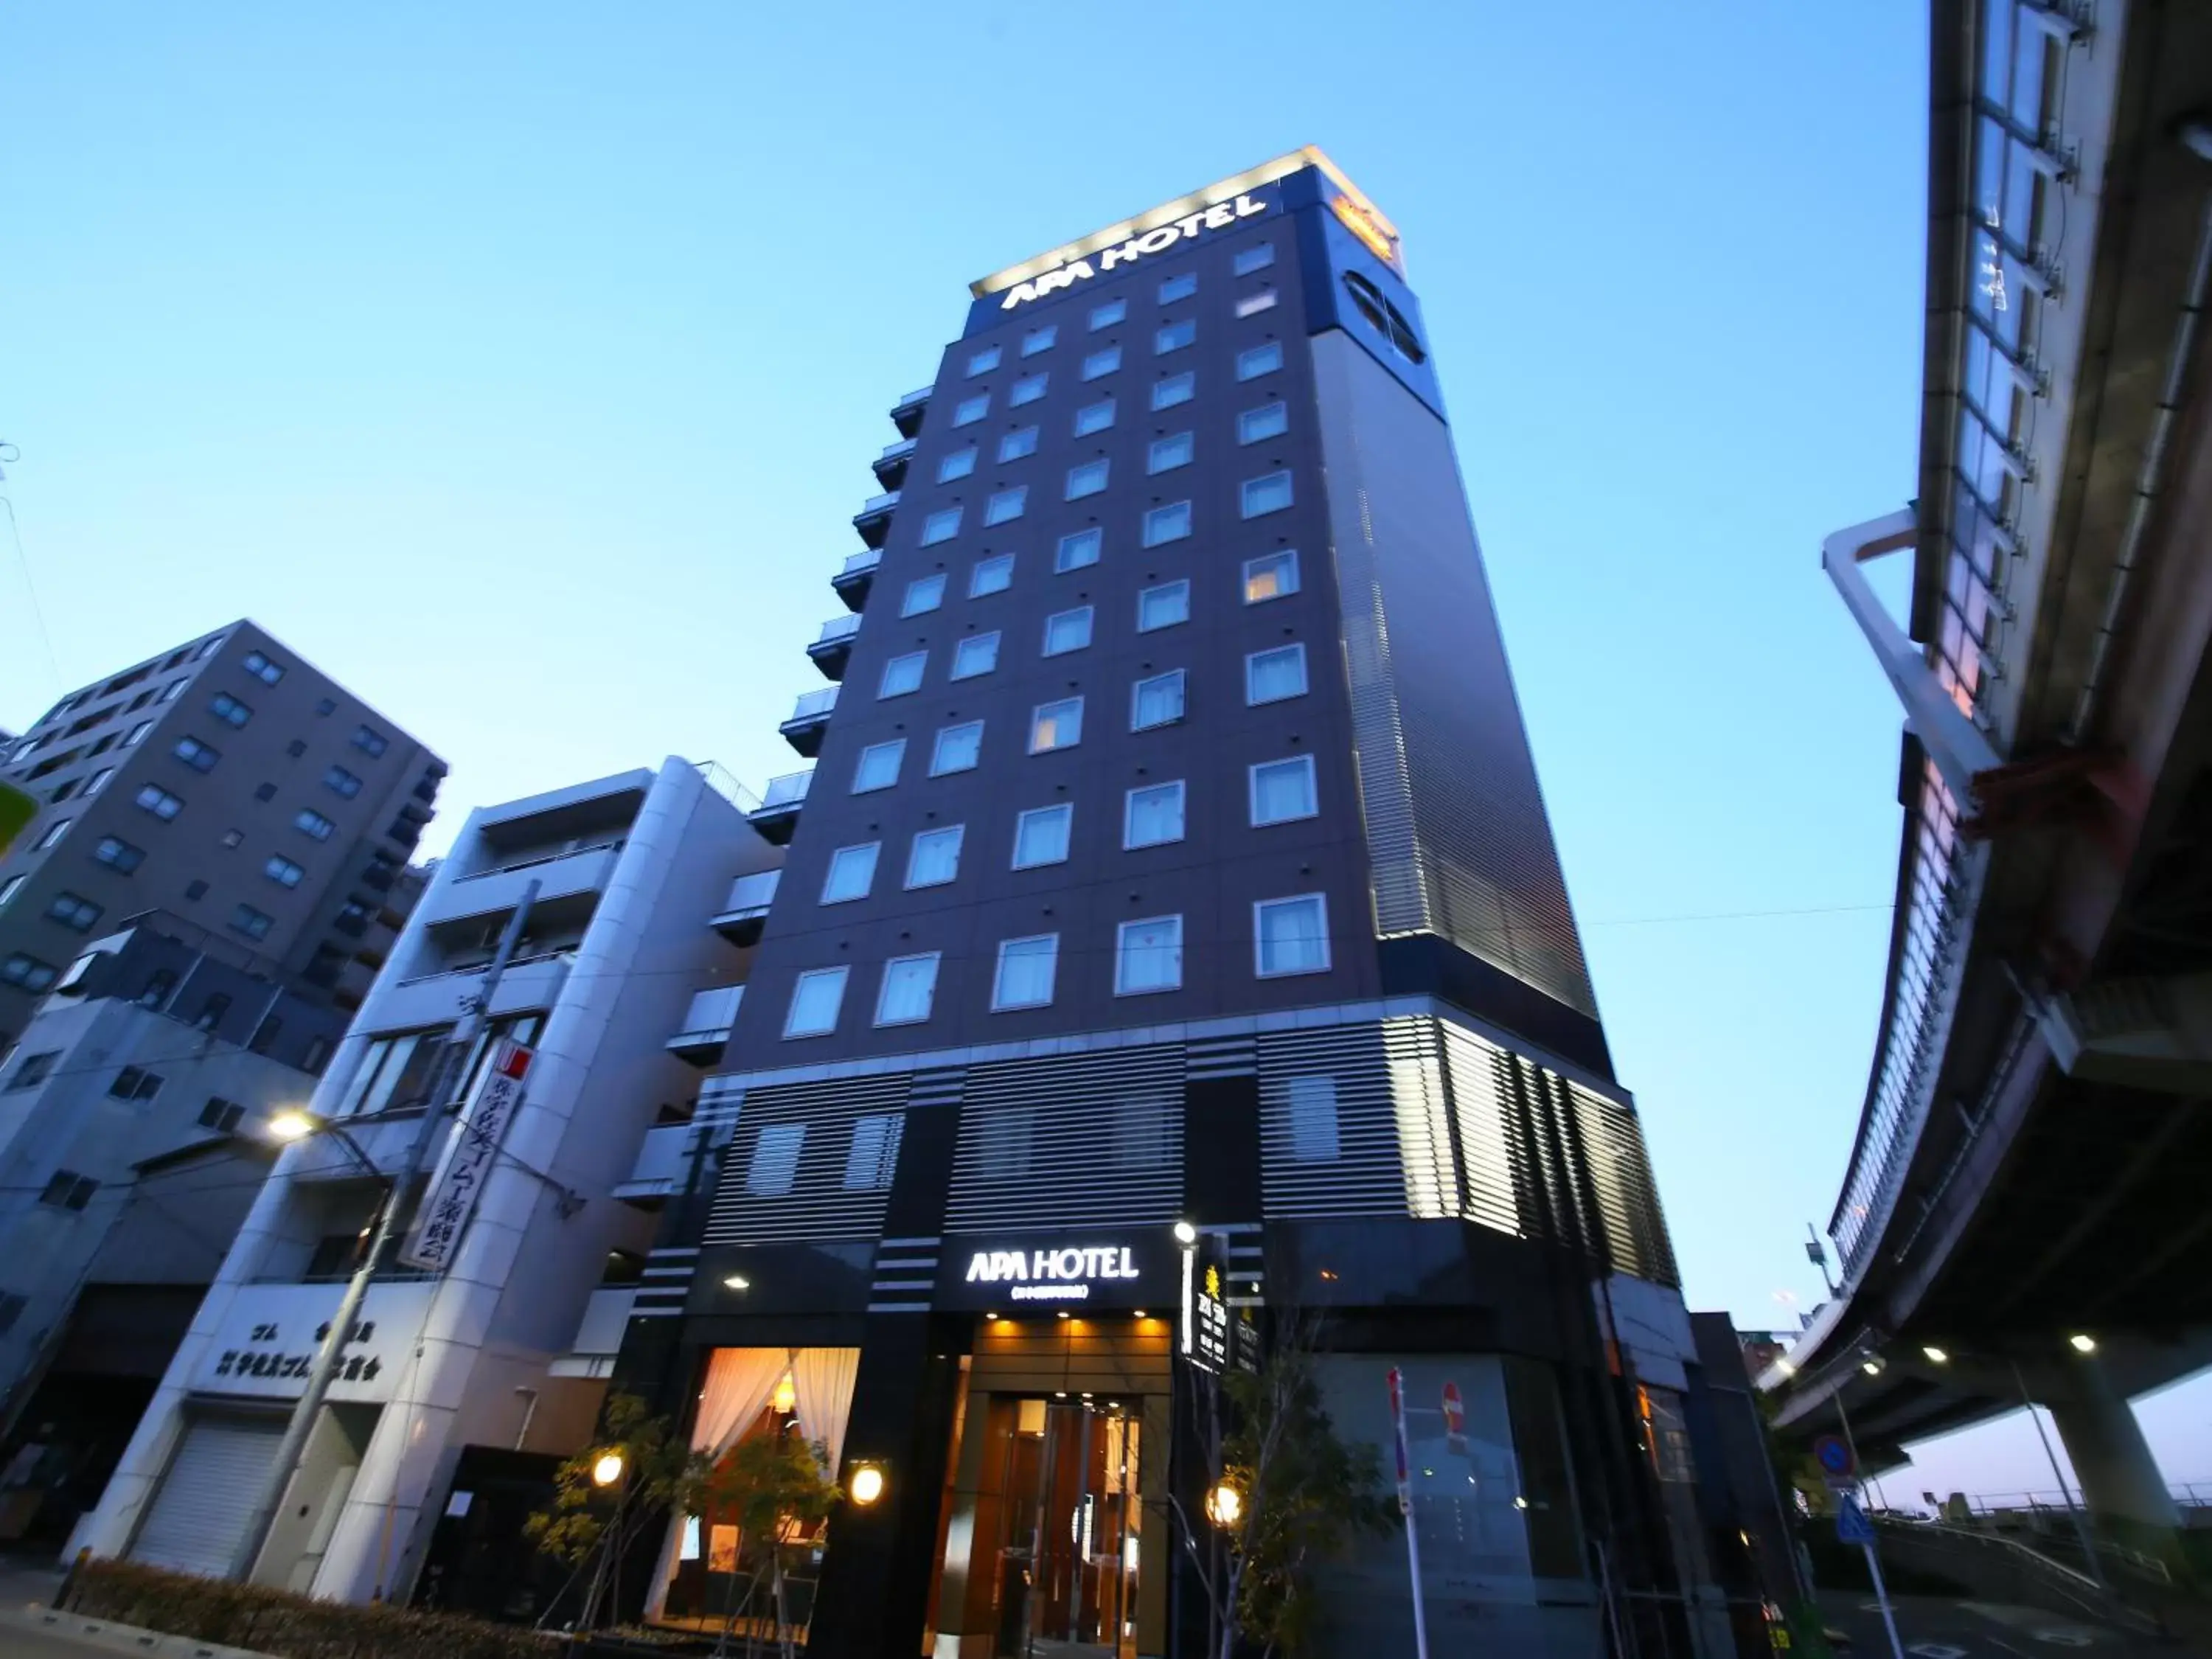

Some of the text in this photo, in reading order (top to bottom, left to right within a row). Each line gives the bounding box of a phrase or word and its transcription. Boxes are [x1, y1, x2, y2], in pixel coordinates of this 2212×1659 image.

[1001, 261, 1094, 310] APA
[1100, 195, 1267, 271] HOTEL
[965, 1247, 1140, 1282] APA HOTEL
